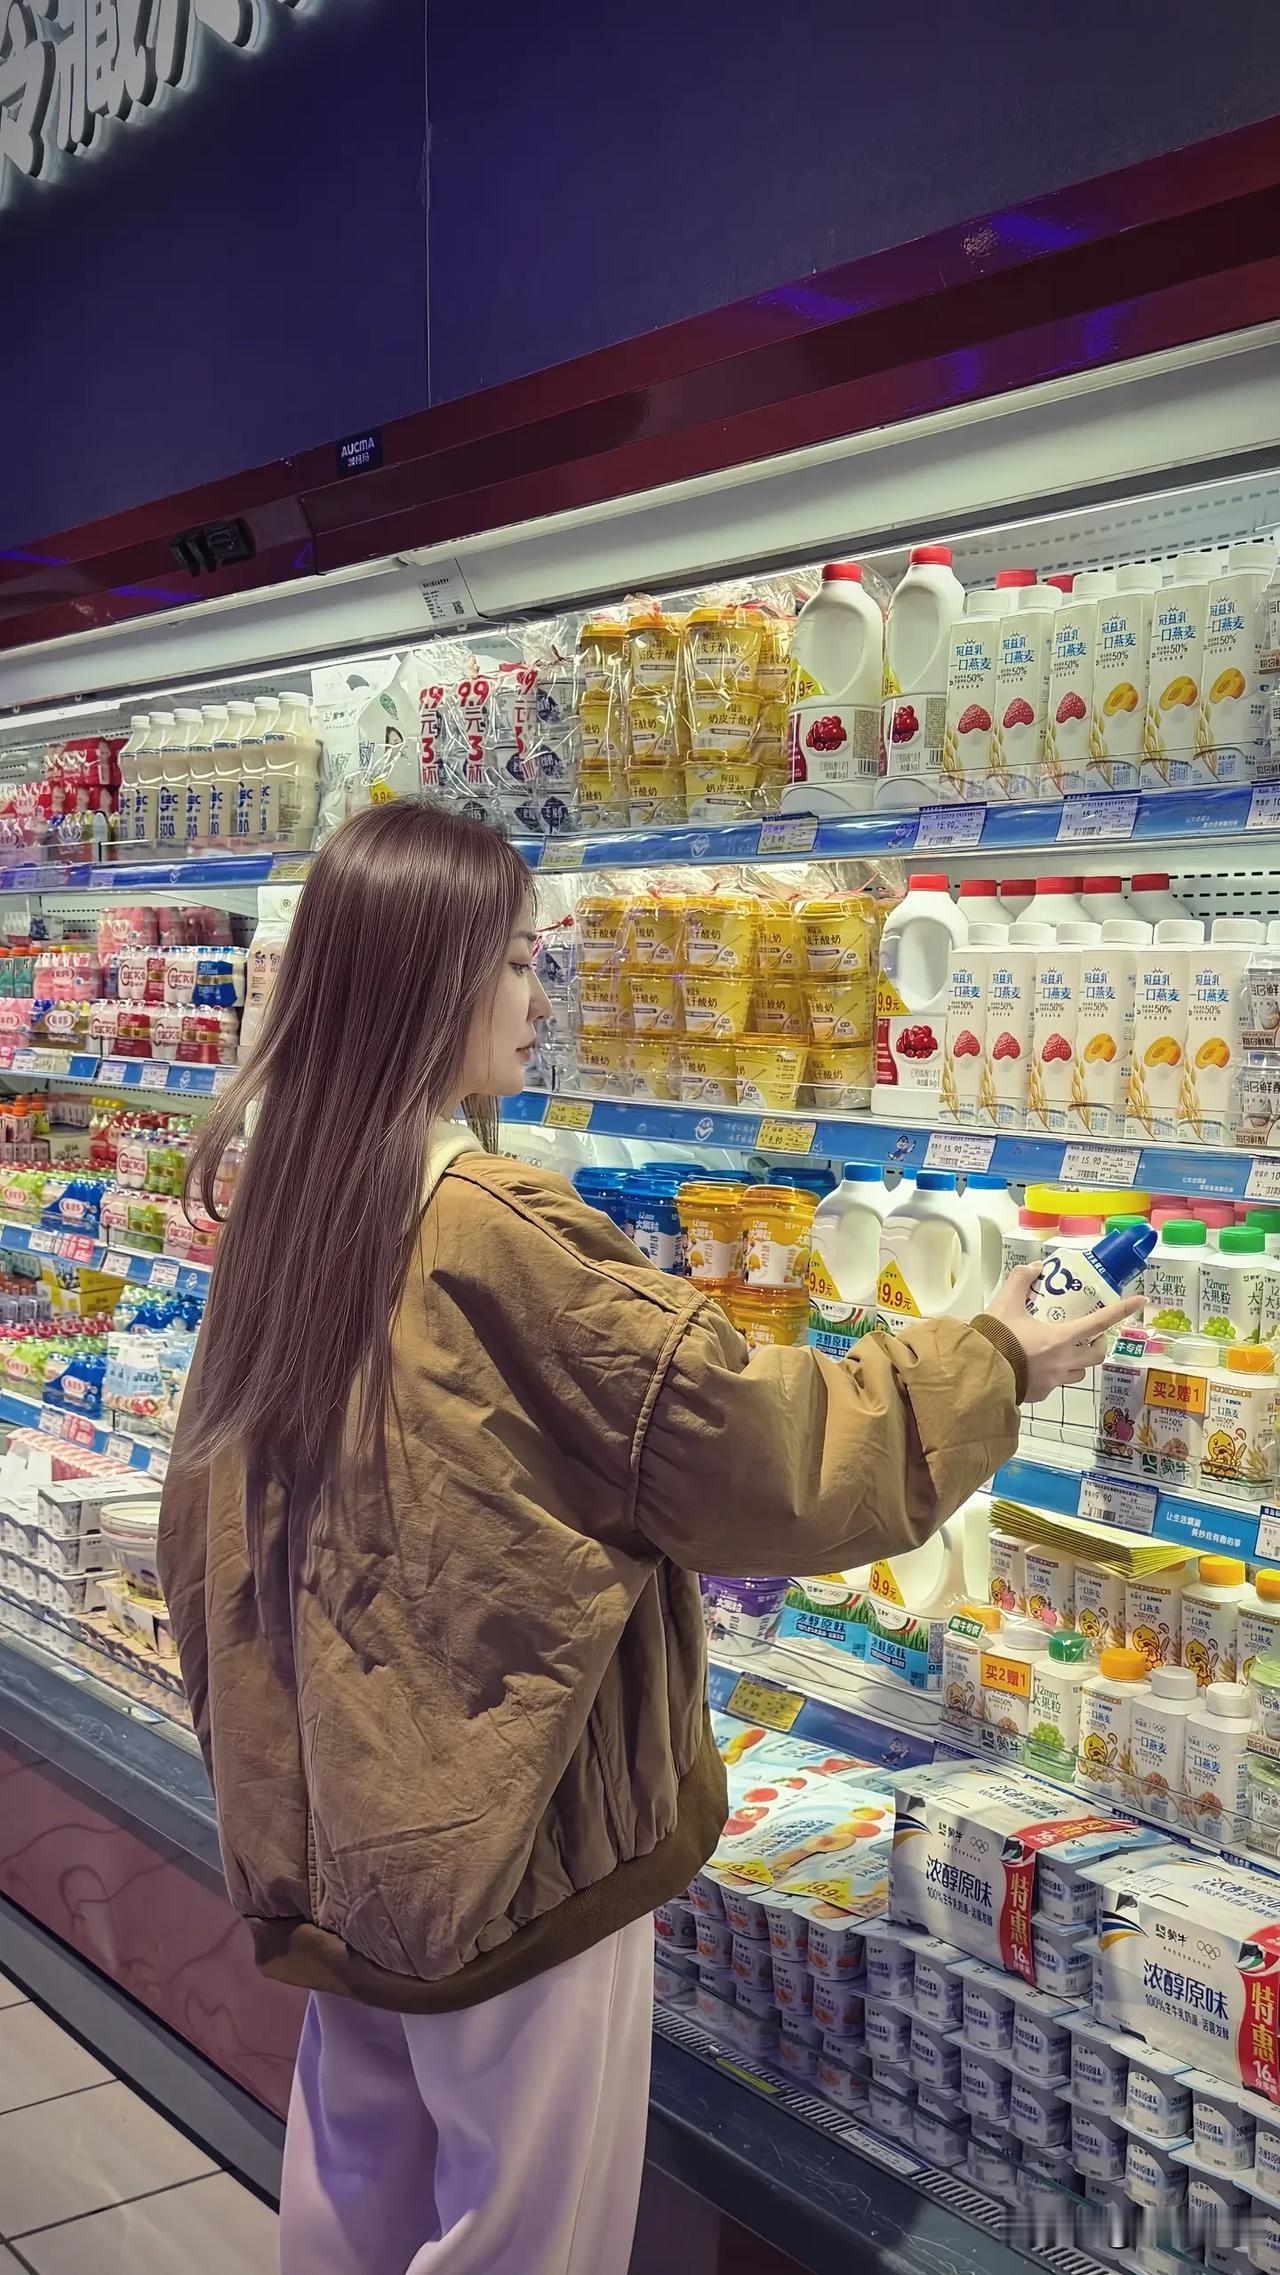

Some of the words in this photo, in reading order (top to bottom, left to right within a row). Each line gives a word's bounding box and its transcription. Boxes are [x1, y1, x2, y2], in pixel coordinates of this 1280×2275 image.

[341, 436, 375, 459] AUCMA
[1210, 602, 1235, 616] 冠益乳
[1159, 611, 1186, 626] 冠益乳
[1204, 615, 1245, 633] 一口燕麦
[1102, 620, 1127, 634] 冠益乳
[1152, 625, 1196, 641] 一口燕麦
[1003, 637, 1026, 650] 冠益乳
[1056, 629, 1079, 644] 冠益乳
[1096, 633, 1136, 649] 一口燕麦
[1220, 634, 1237, 646] 50%
[956, 644, 982, 656] 冠益乳
[1050, 642, 1087, 658] 一口燕麦
[1112, 650, 1129, 661] 50%
[1170, 643, 1188, 654] 50%
[950, 657, 992, 671] 一口燕麦
[996, 650, 1034, 664] 一口燕麦
[1064, 659, 1080, 669] 50%
[1012, 666, 1028, 675] 50%
[967, 673, 984, 683] 50%
[952, 973, 974, 984] 冠益乳
[992, 973, 1013, 984] 冠益乳
[1040, 973, 1063, 985] 冠益乳
[1084, 972, 1107, 984] 冠益乳
[1143, 974, 1171, 986] 冠益乳
[1195, 974, 1220, 986] 冠益乳
[948, 986, 981, 998] 一口燕麦
[987, 986, 1021, 999] 一口燕麦
[1036, 987, 1072, 1000] 一口燕麦
[1079, 986, 1116, 1000] 一口燕麦
[1136, 988, 1181, 1002] 一口燕麦
[1189, 988, 1230, 1003] 一口燕麦
[877, 991, 901, 1013] 9.9元
[960, 1000, 974, 1010] 50%
[1000, 1001, 1014, 1011] 50%
[1049, 1002, 1065, 1012] 50%
[1093, 1001, 1109, 1012] 50%
[1154, 1004, 1172, 1014] 50%
[1204, 1005, 1222, 1015] 50%
[809, 1271, 833, 1297] 9.9元
[1155, 1271, 1184, 1284] 12mm
[1205, 1278, 1230, 1291] 12mm
[881, 1282, 912, 1310] 9.9元
[1149, 1282, 1187, 1297] 大果粒
[1201, 1288, 1231, 1305] 大果粒
[1051, 1309, 1062, 1321] 15
[1153, 1380, 1199, 1404] 买2赠1
[1160, 1456, 1191, 1481] 蒙牛
[871, 1569, 897, 1600] 9.9元
[985, 1663, 1026, 1687] 买2赠1
[996, 1735, 1022, 1753] 蒙牛
[1133, 1735, 1168, 1755] 一口燕麦
[1186, 1754, 1221, 1774] 一口燕麦
[948, 1825, 964, 1844] 蒙牛
[926, 1853, 993, 1909] 浓醇原味
[1011, 1871, 1031, 1946] 特惠
[1167, 1928, 1189, 1947] 蒙牛
[1143, 1957, 1229, 2021] 浓醇原味
[1251, 1981, 1275, 2065] 特惠
